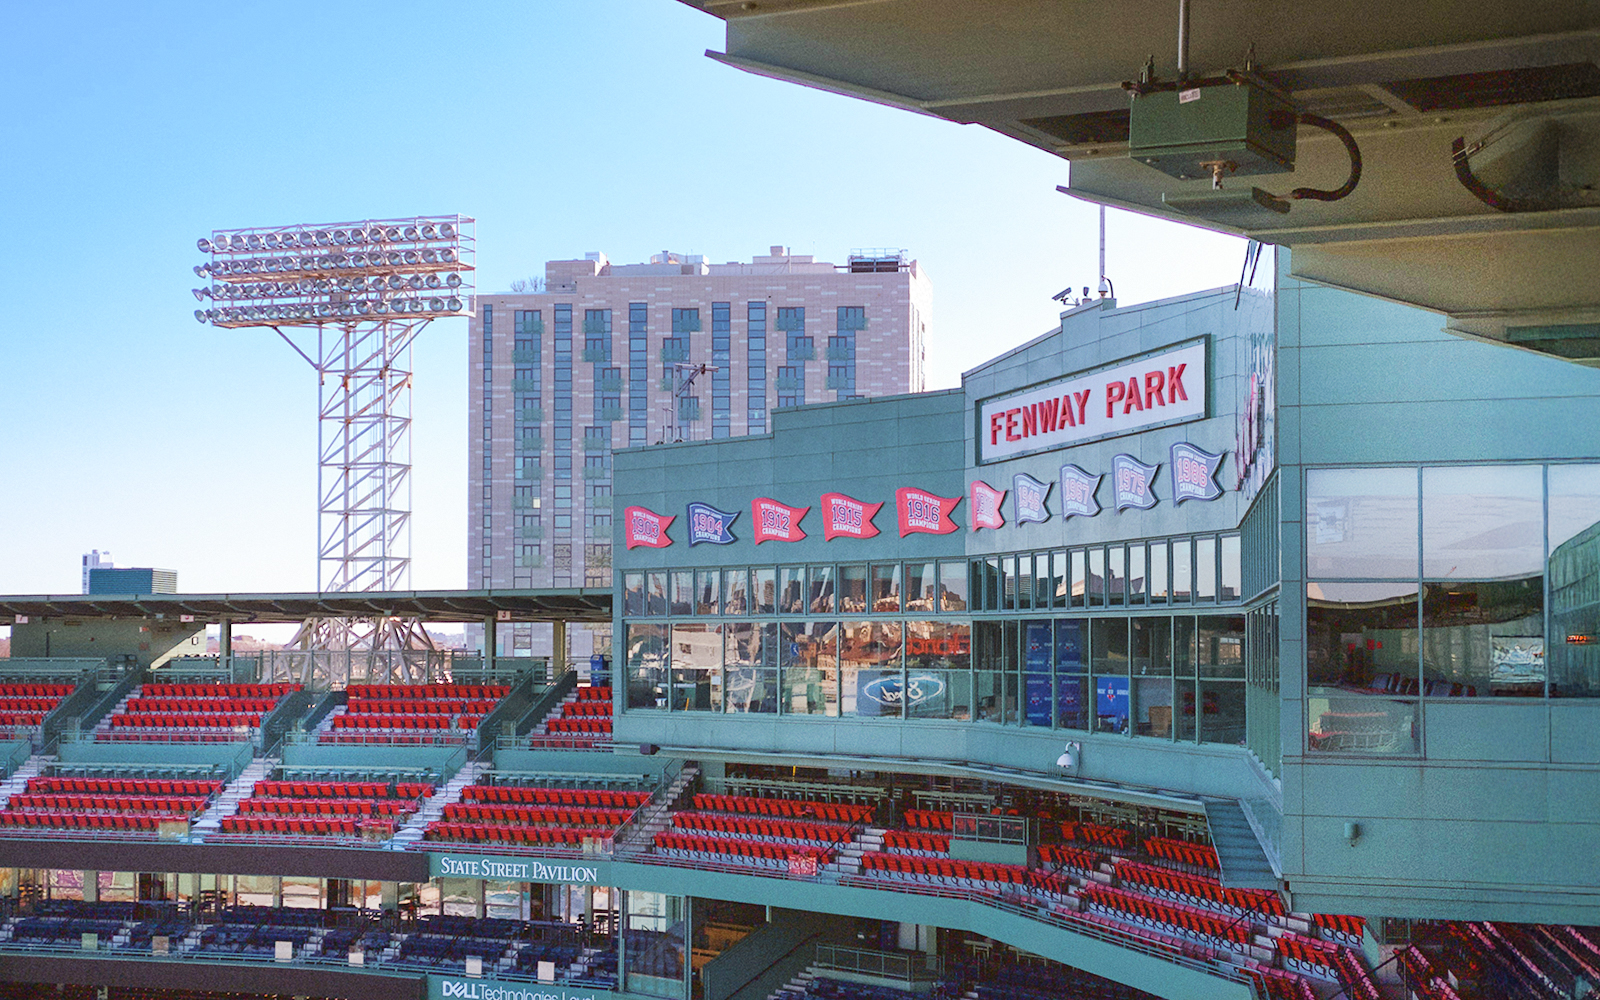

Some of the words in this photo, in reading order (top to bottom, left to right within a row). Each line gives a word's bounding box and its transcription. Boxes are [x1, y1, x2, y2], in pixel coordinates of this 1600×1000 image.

[991, 389, 1091, 445] FENWAY
[1106, 363, 1188, 418] PARK
[1118, 469, 1145, 496] 1975
[1177, 458, 1208, 487] 1986
[762, 510, 790, 532] 1912
[832, 505, 863, 527] 1915
[907, 500, 940, 523] 1916
[632, 517, 660, 539] 1903
[693, 513, 723, 536] 1904
[832, 522, 862, 535] CHAMPIONS
[908, 518, 939, 530] CHAMPIONS
[441, 857, 479, 876] STATE
[532, 861, 598, 883] PAVILION
[442, 980, 479, 1000] DELL
